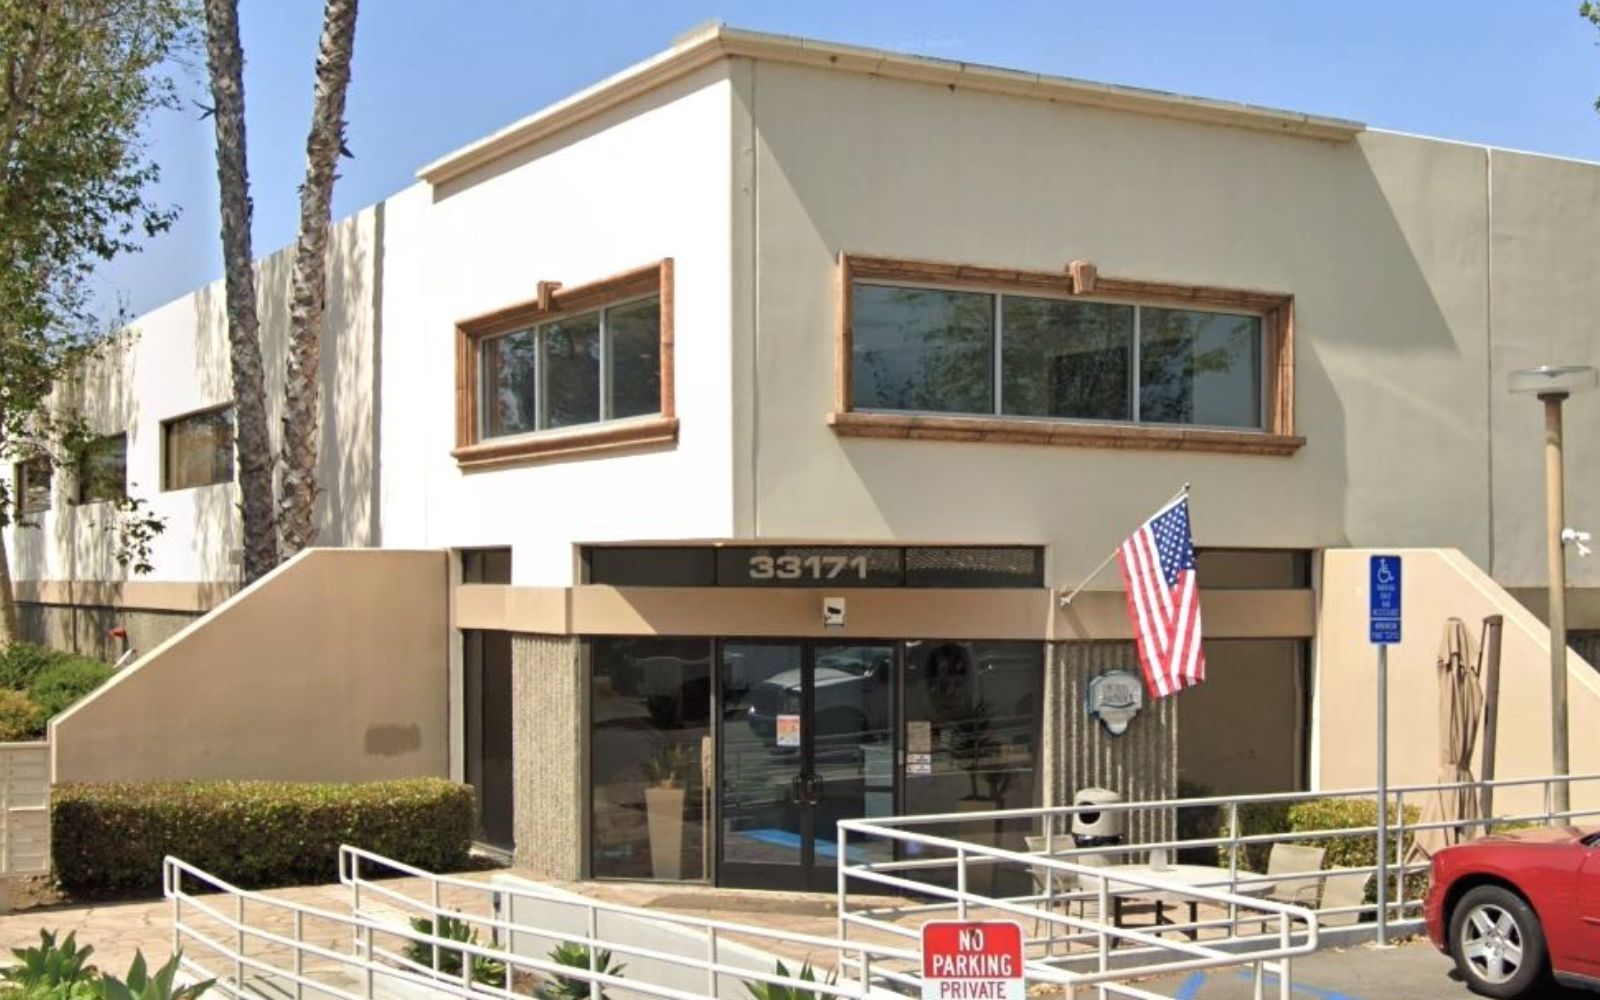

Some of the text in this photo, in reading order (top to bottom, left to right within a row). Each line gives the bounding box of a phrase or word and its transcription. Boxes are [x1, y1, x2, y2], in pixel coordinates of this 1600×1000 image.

[750, 555, 867, 579] 33171
[959, 928, 984, 951] NO
[932, 953, 1012, 977] PARKING
[940, 981, 1007, 999] PRIVATE
